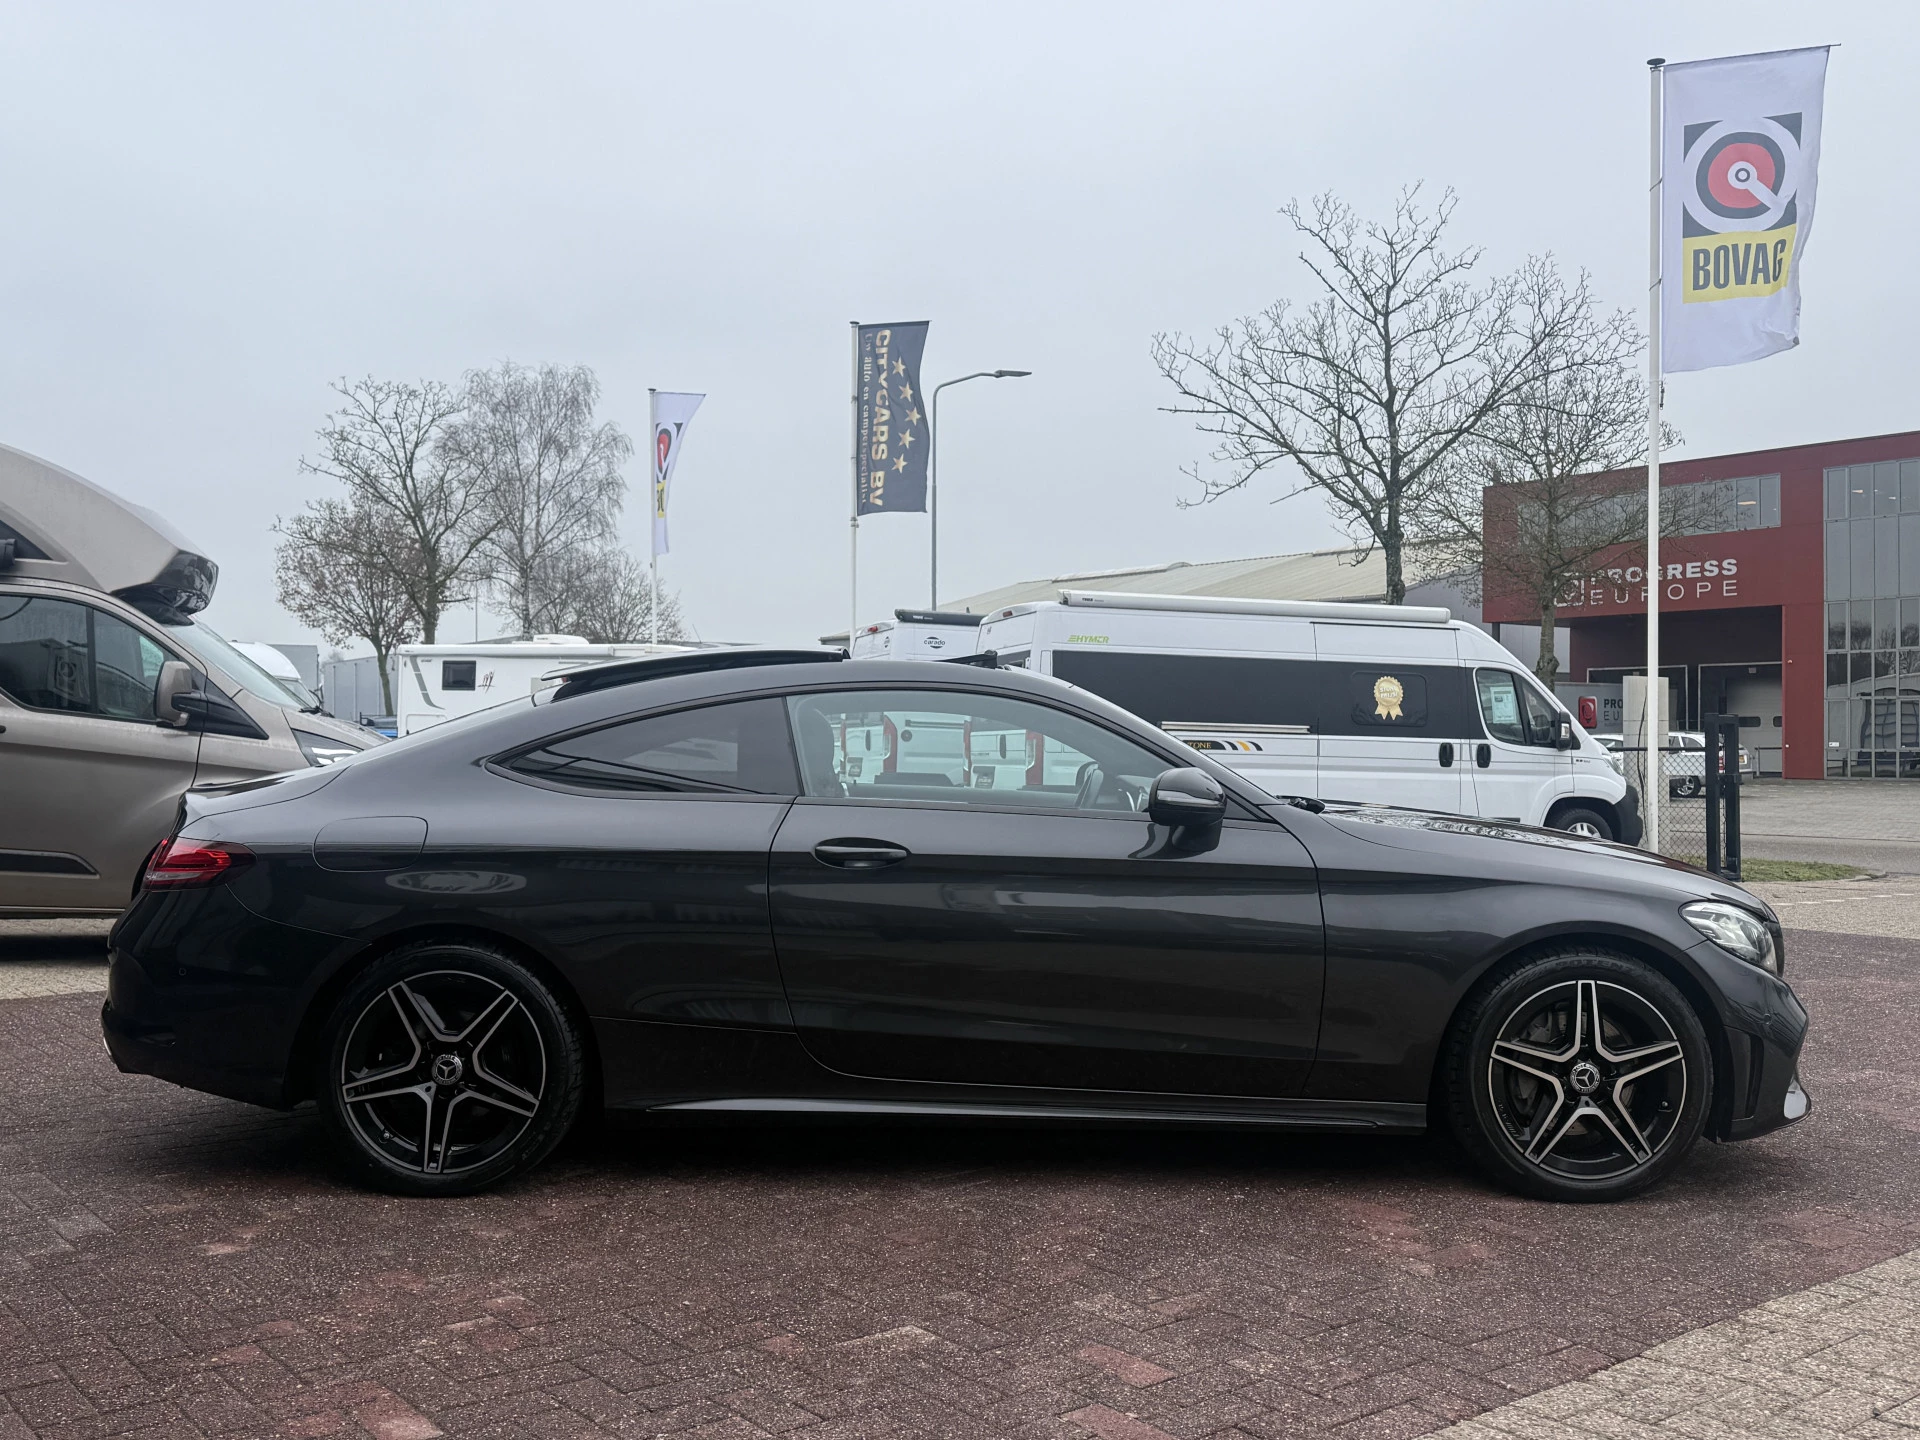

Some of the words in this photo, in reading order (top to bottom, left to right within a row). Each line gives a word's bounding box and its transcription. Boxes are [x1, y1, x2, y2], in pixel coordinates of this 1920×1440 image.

[1692, 238, 1787, 291] BOVAG
[863, 356, 873, 382] auto
[863, 386, 870, 400] en
[869, 470, 885, 506] BV
[1603, 698, 1623, 709] PRO
[1603, 710, 1620, 721] EU
[1187, 741, 1212, 750] TONE
